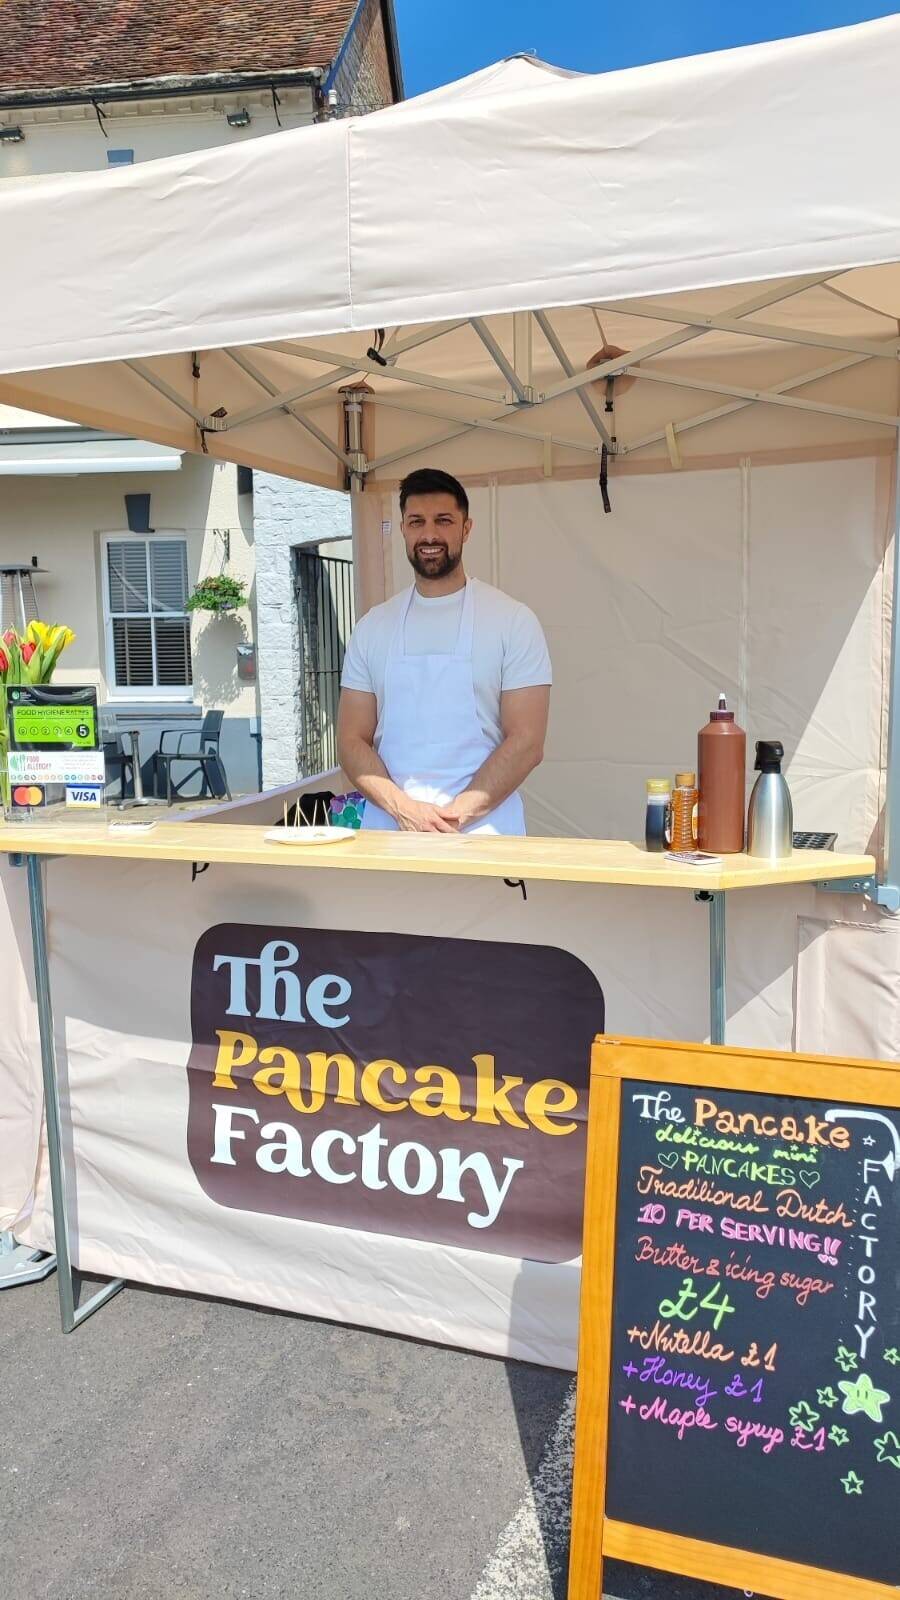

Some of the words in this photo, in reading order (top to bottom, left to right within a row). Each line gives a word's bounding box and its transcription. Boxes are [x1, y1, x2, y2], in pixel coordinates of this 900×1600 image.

[79, 726, 87, 737] 5
[72, 791, 97, 802] VISA
[213, 940, 352, 1028] The
[211, 1029, 579, 1136] Pancake
[632, 1091, 686, 1123] The
[694, 1098, 850, 1149] Pancake
[209, 1102, 525, 1229] Factory
[655, 1124, 760, 1155] delicious
[772, 1144, 819, 1164] mini
[682, 1150, 797, 1187] PANCAKES
[775, 1188, 856, 1228] Dutch
[637, 1203, 667, 1225] 10
[676, 1208, 715, 1235] PER
[720, 1216, 842, 1266] SERVING!!
[634, 1235, 705, 1275] Butter
[705, 1258, 721, 1277] &
[725, 1250, 776, 1299] icing
[780, 1274, 835, 1306] sugar
[855, 1158, 882, 1360] FACTORY
[658, 1277, 736, 1331] £4
[740, 1342, 779, 1372] £1
[724, 1373, 764, 1403] £1
[724, 1415, 784, 1454] syrup
[790, 1424, 826, 1452] £1
